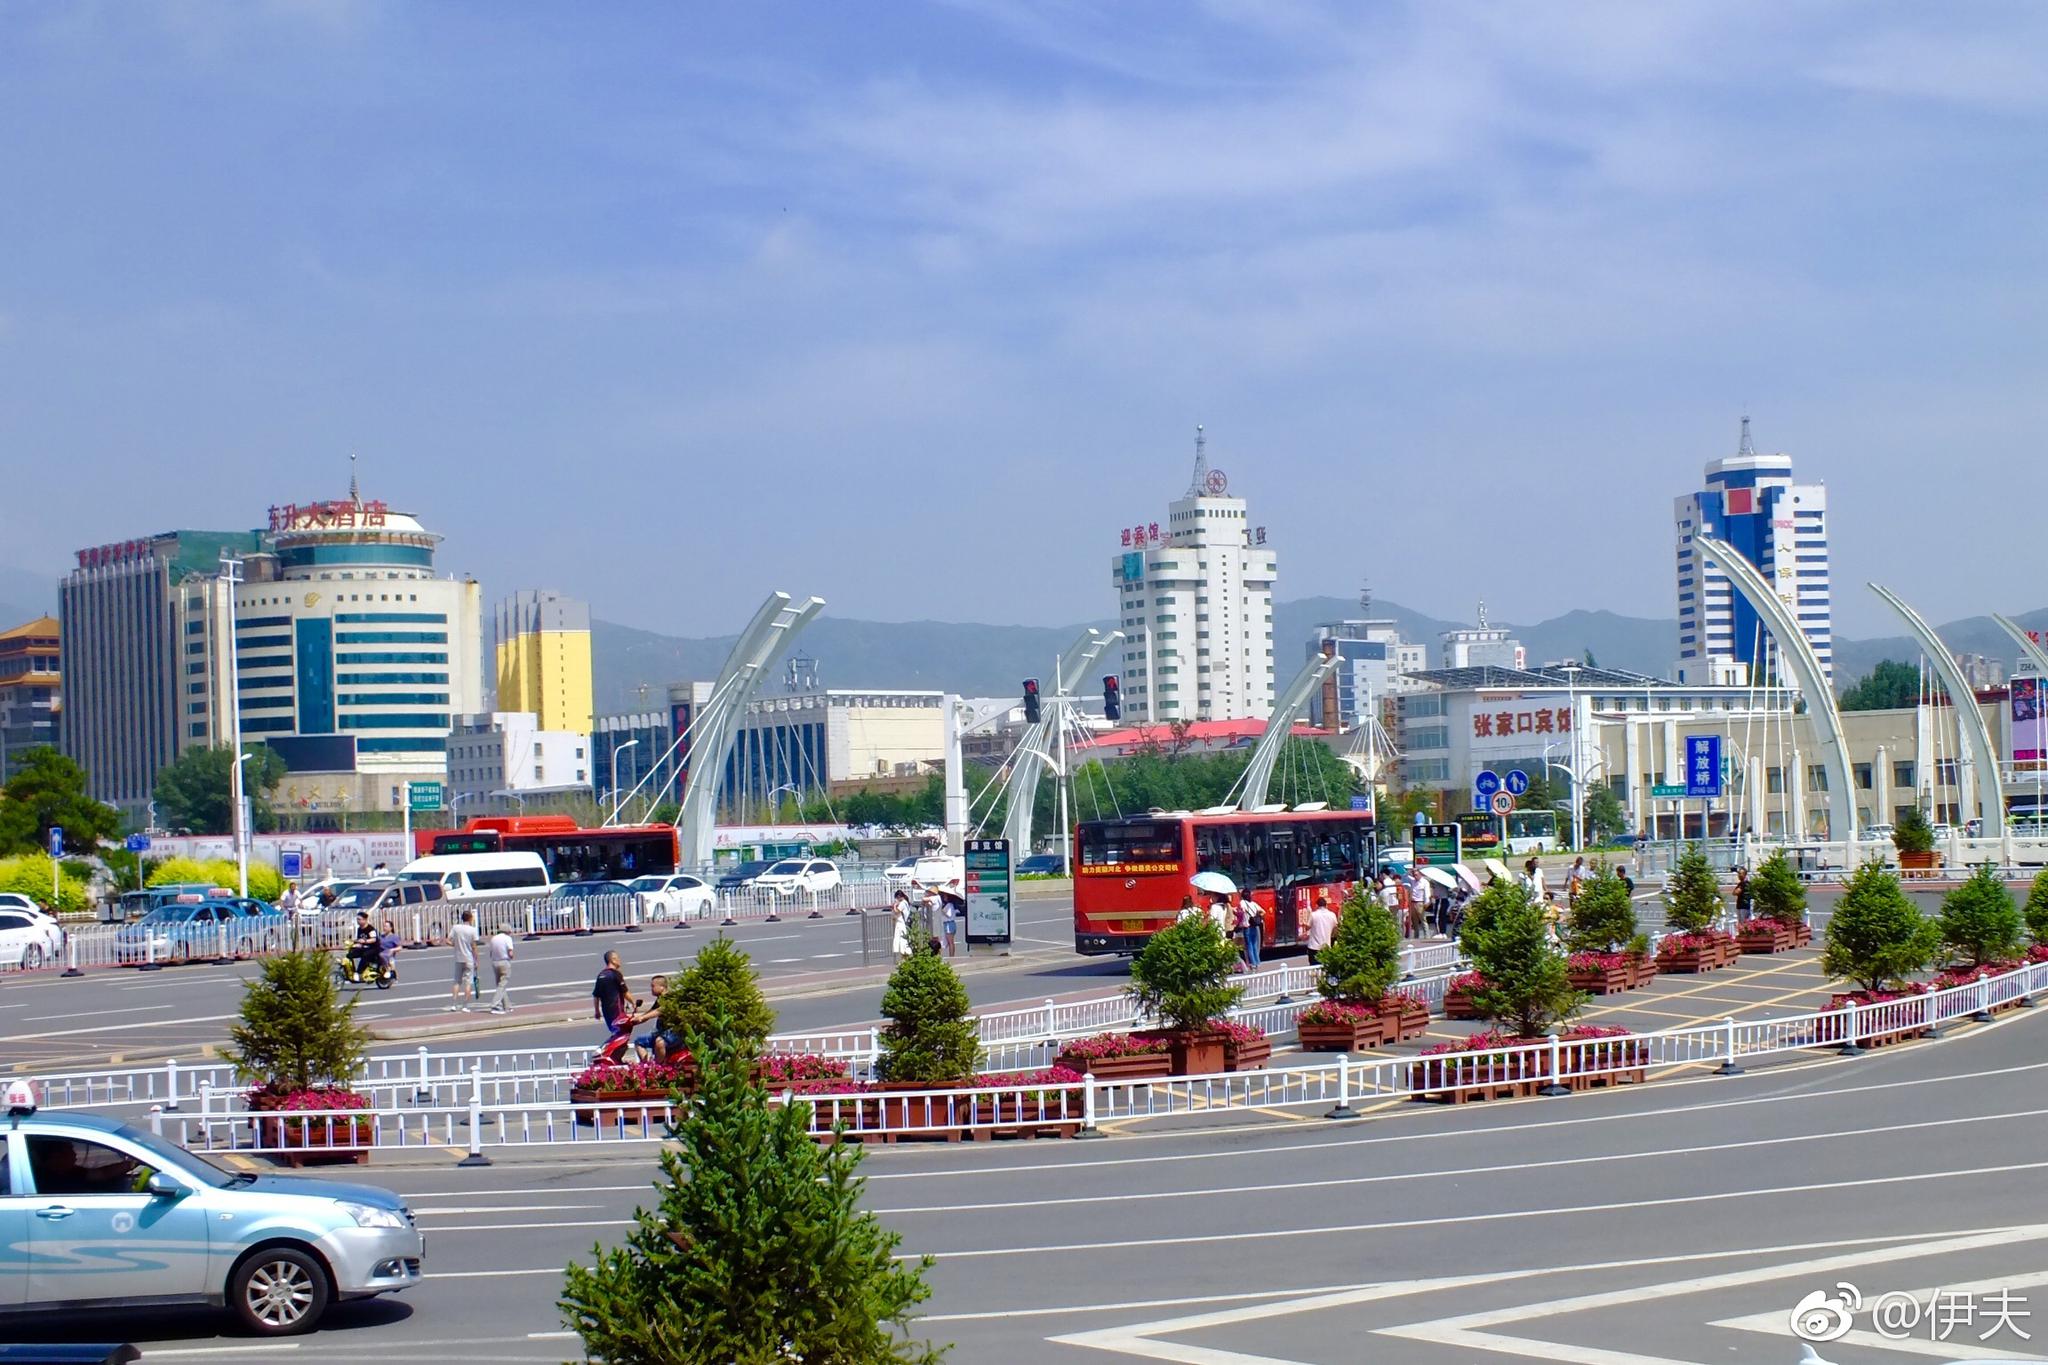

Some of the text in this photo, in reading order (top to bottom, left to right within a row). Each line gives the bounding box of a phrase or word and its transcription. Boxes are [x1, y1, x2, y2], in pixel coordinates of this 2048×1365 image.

[267, 500, 387, 532] 东升大酒店
[1120, 521, 1160, 547] 迎宾馆
[1473, 706, 1576, 738] 张家口宾馆
[1695, 740, 1711, 786] 解放桥
